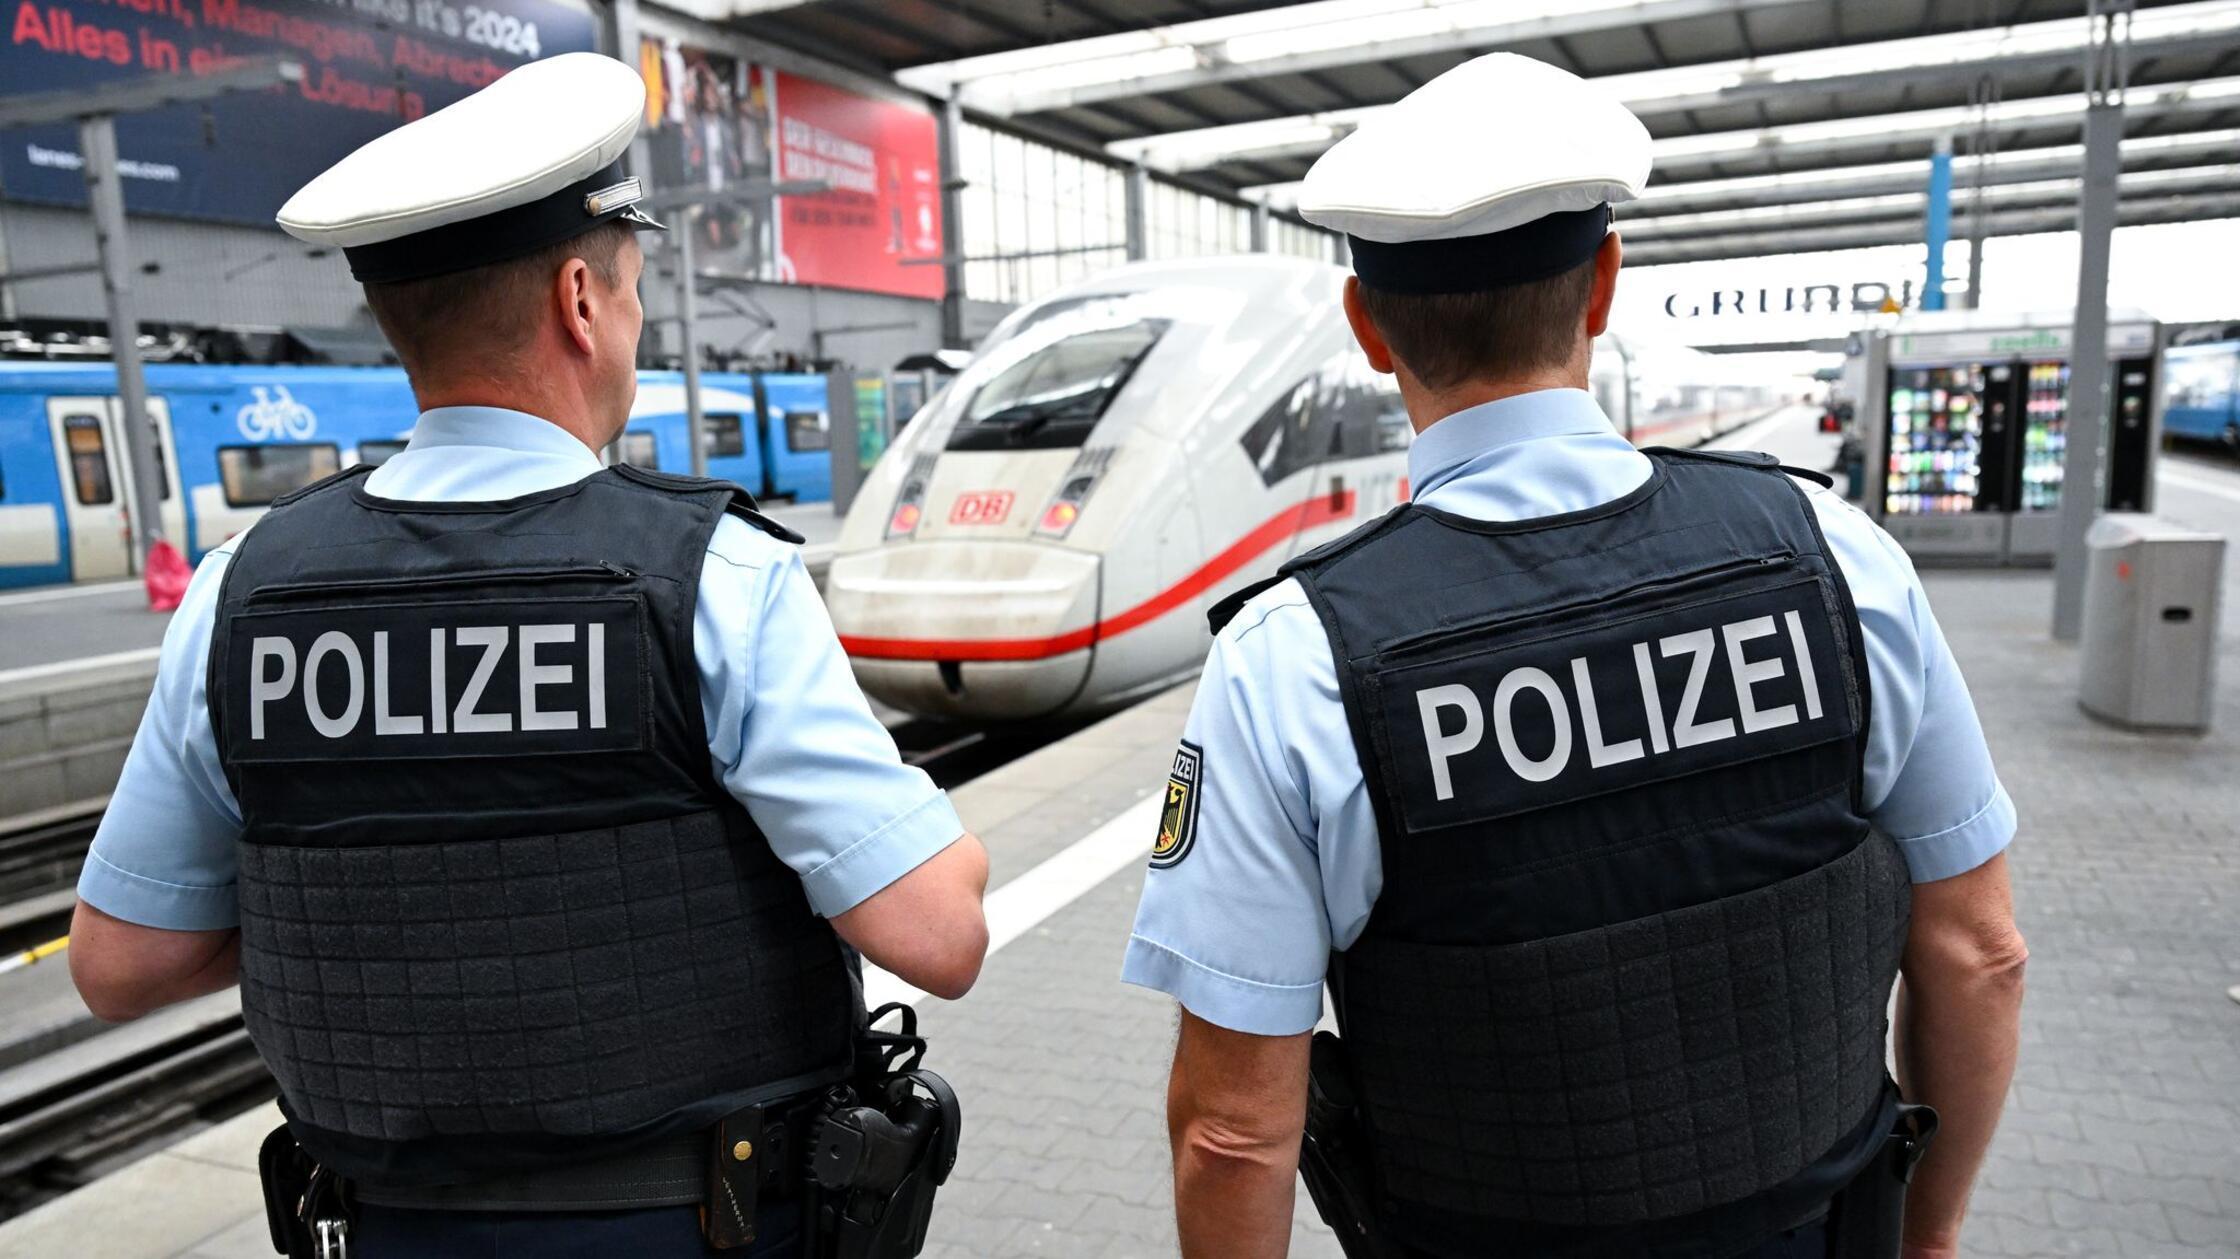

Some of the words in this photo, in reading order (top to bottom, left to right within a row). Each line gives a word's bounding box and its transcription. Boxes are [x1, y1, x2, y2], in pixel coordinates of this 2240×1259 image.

[12, 1, 132, 65] Alles
[139, 27, 180, 74] in
[463, 5, 542, 58] 2024
[1664, 279, 1912, 318] GRUNDI
[251, 623, 607, 740] POLIZEI
[1416, 610, 1824, 801] POLIZEI
[1172, 753, 1196, 781] IZEI
